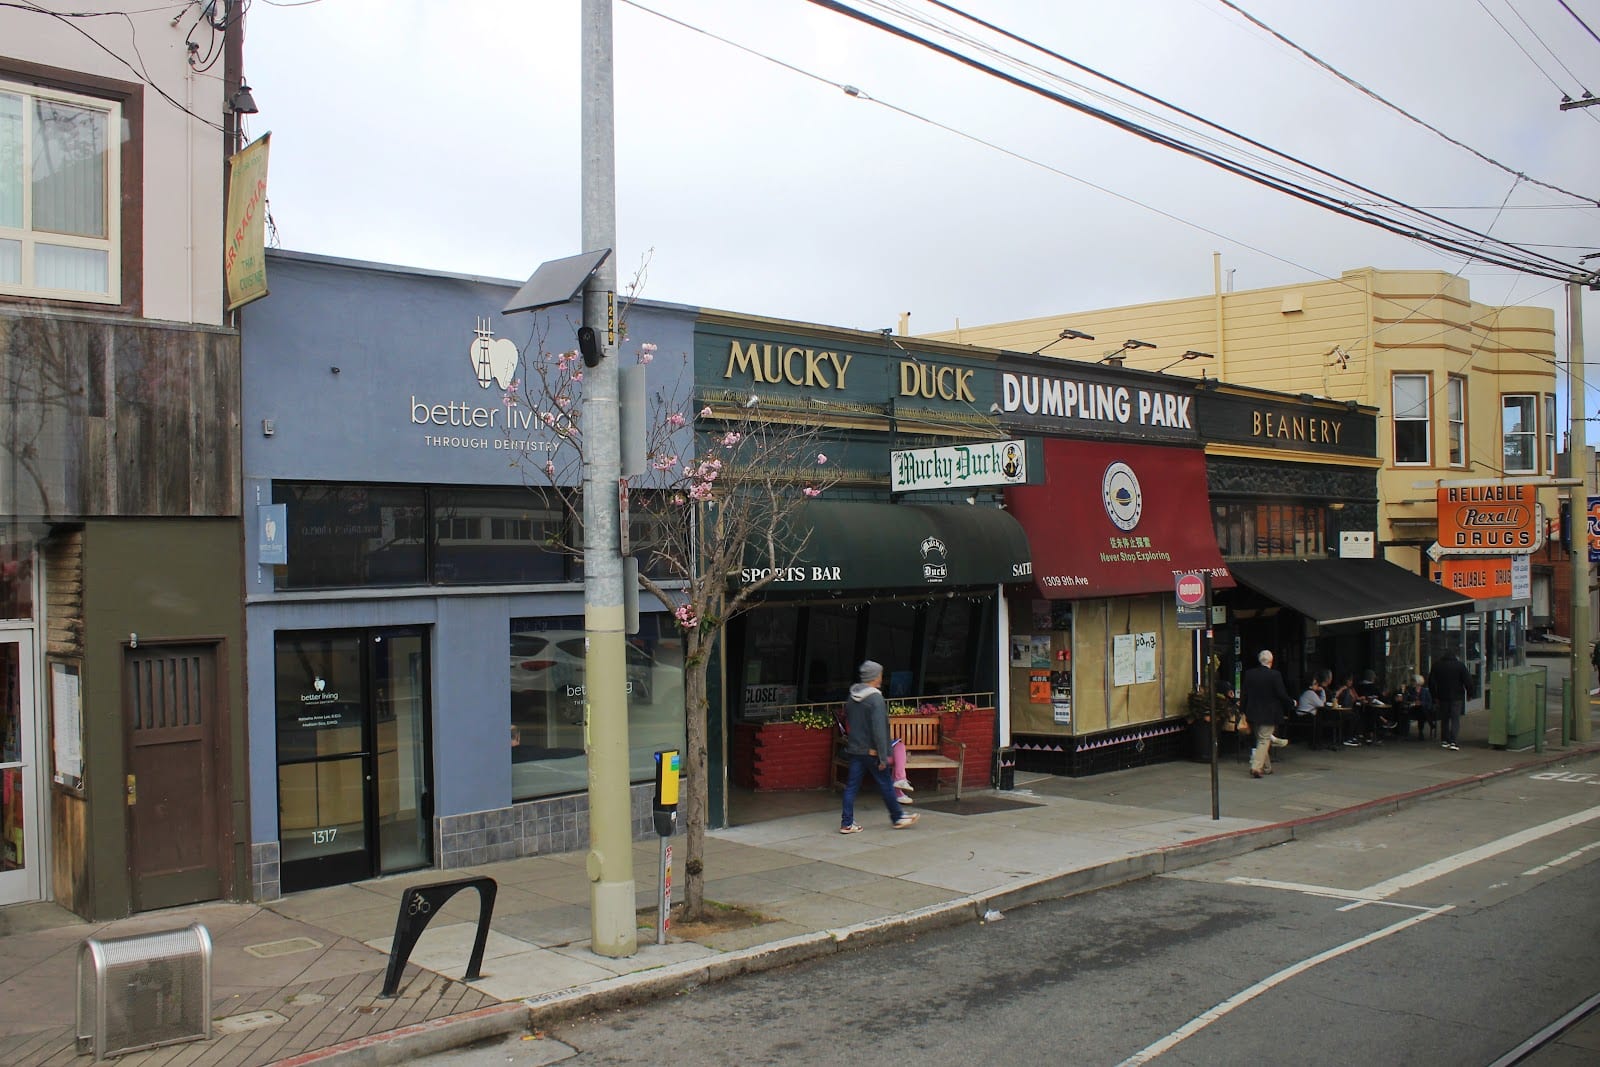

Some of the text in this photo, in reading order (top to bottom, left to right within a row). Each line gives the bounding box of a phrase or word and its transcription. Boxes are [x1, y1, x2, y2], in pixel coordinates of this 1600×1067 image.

[226, 179, 266, 276] SRIRACHA
[723, 340, 976, 402] MUCKY DUCK
[1003, 373, 1191, 429] DUMPLING PARK
[411, 395, 572, 439] better living
[1252, 410, 1341, 444] BEANERY
[425, 435, 560, 452] THROUGH DENTISTRY
[898, 449, 953, 486] Mucky
[953, 444, 1001, 480] Duck
[1448, 486, 1524, 502] RELIABLE
[1463, 508, 1519, 527] Rexall
[1456, 531, 1530, 546] DRUGS
[1100, 550, 1171, 563] Never Stop Exploring
[741, 566, 842, 583] SPORTS BAR
[924, 566, 946, 576] Duck
[1453, 569, 1512, 590] RELIABLE DRUG
[1042, 575, 1089, 587] 1309 9th Ave
[1364, 620, 1374, 629] THE
[1374, 617, 1389, 628] LITTLE
[1389, 614, 1411, 626] ROASTER
[1410, 612, 1423, 622] THAT
[301, 692, 339, 702] better living
[566, 684, 587, 697] bet
[311, 828, 337, 845] 1317
